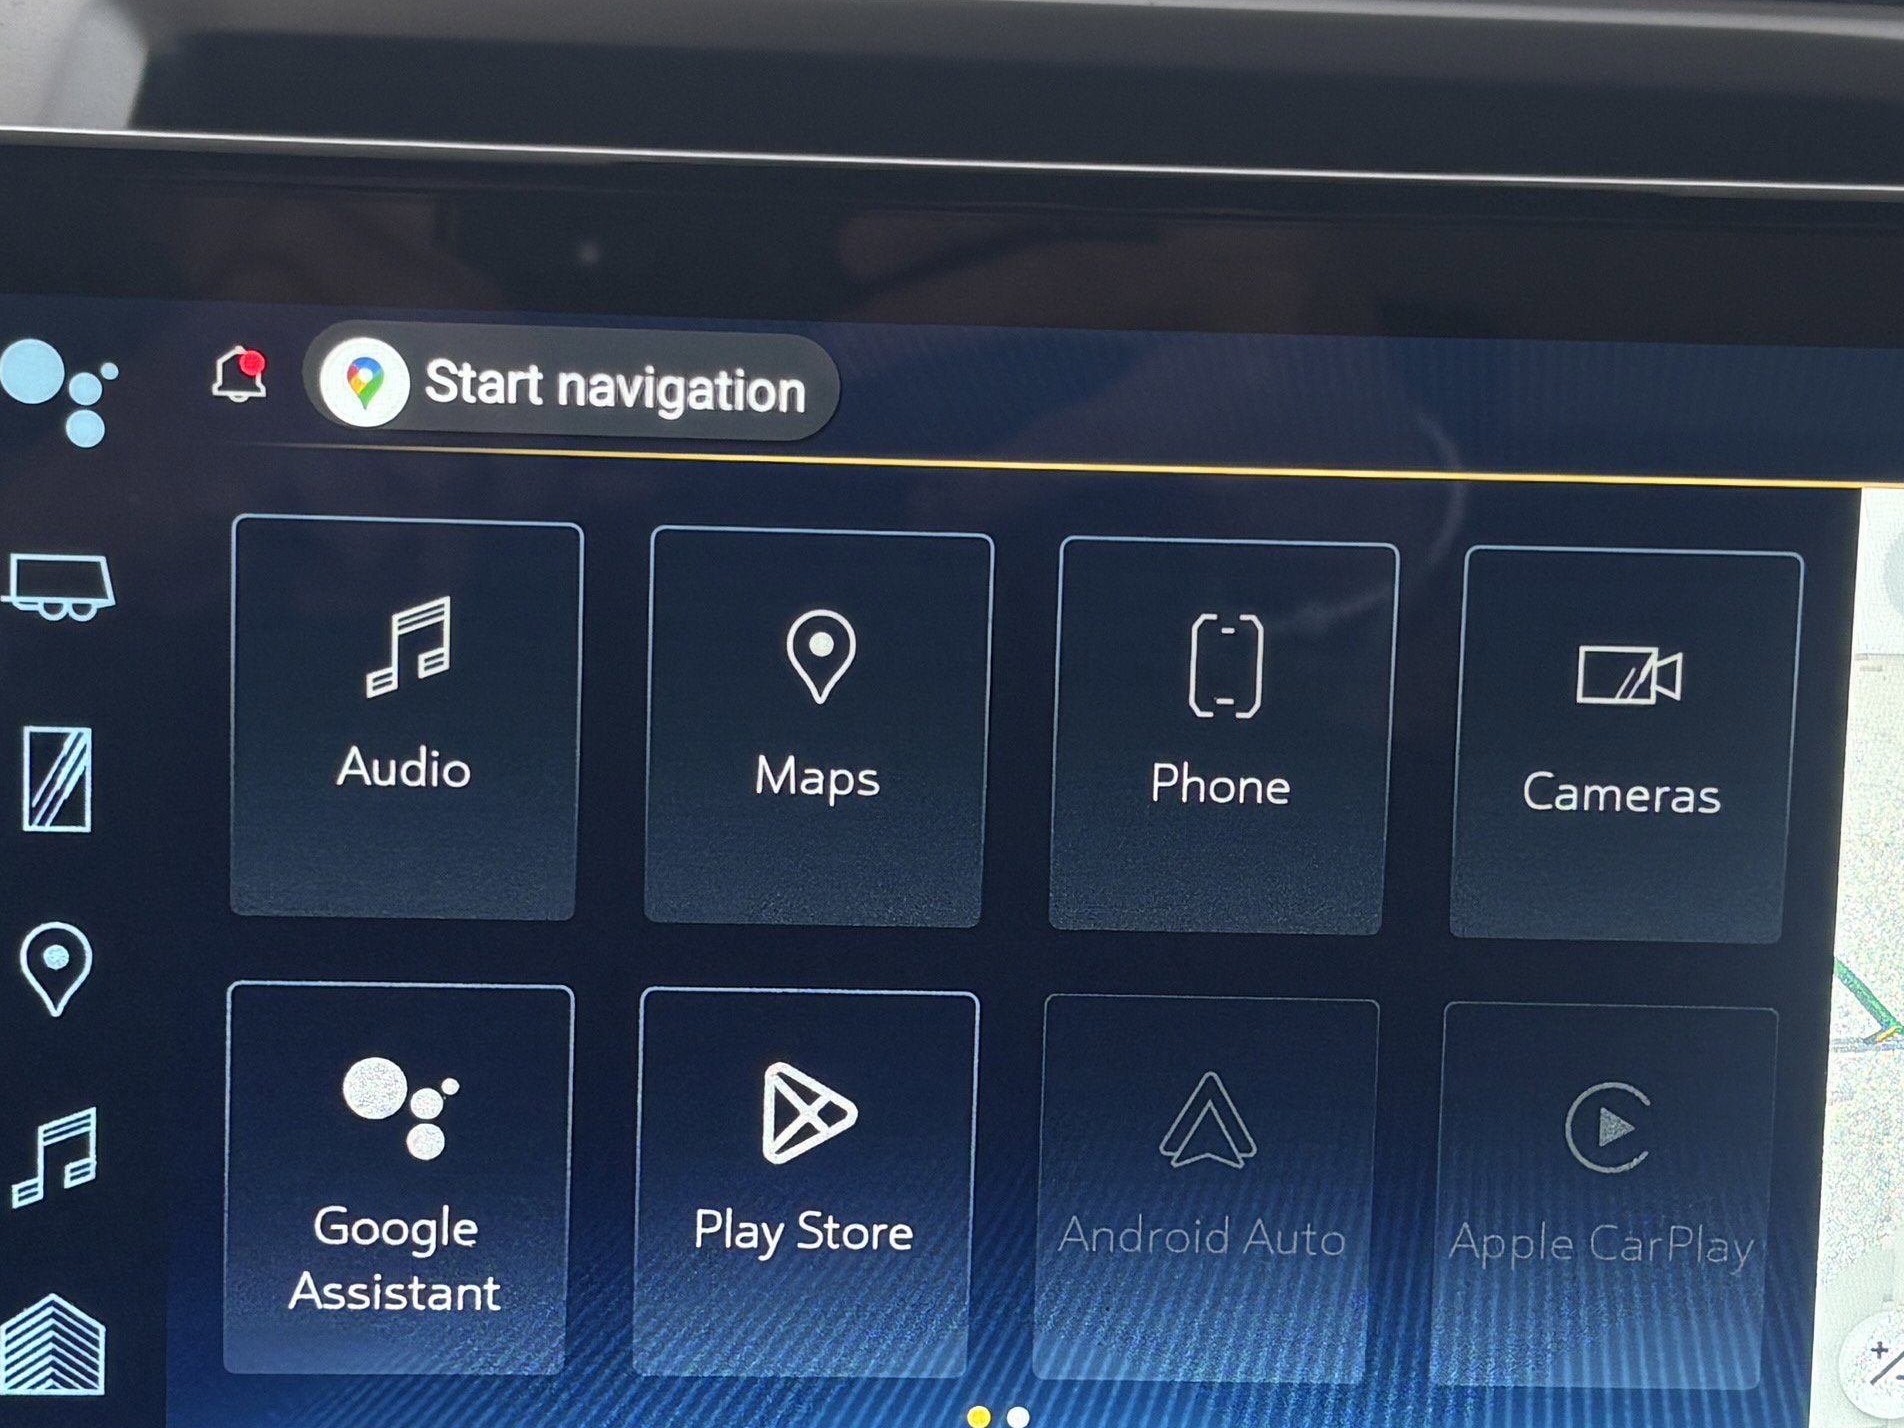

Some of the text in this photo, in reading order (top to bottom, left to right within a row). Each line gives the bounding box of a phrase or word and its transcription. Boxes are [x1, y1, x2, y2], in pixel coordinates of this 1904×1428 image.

[425, 358, 806, 420] Start navigation
[336, 747, 472, 791] Audio
[756, 755, 880, 807] Maps
[1151, 763, 1291, 806] Phone
[1524, 771, 1721, 815] Cameras
[313, 1205, 479, 1258] Google
[695, 1209, 914, 1260] Play Store
[1058, 1214, 1347, 1258] Android Auto
[1448, 1222, 1755, 1275] Apple CarPlay
[288, 1271, 502, 1313] Assistant
